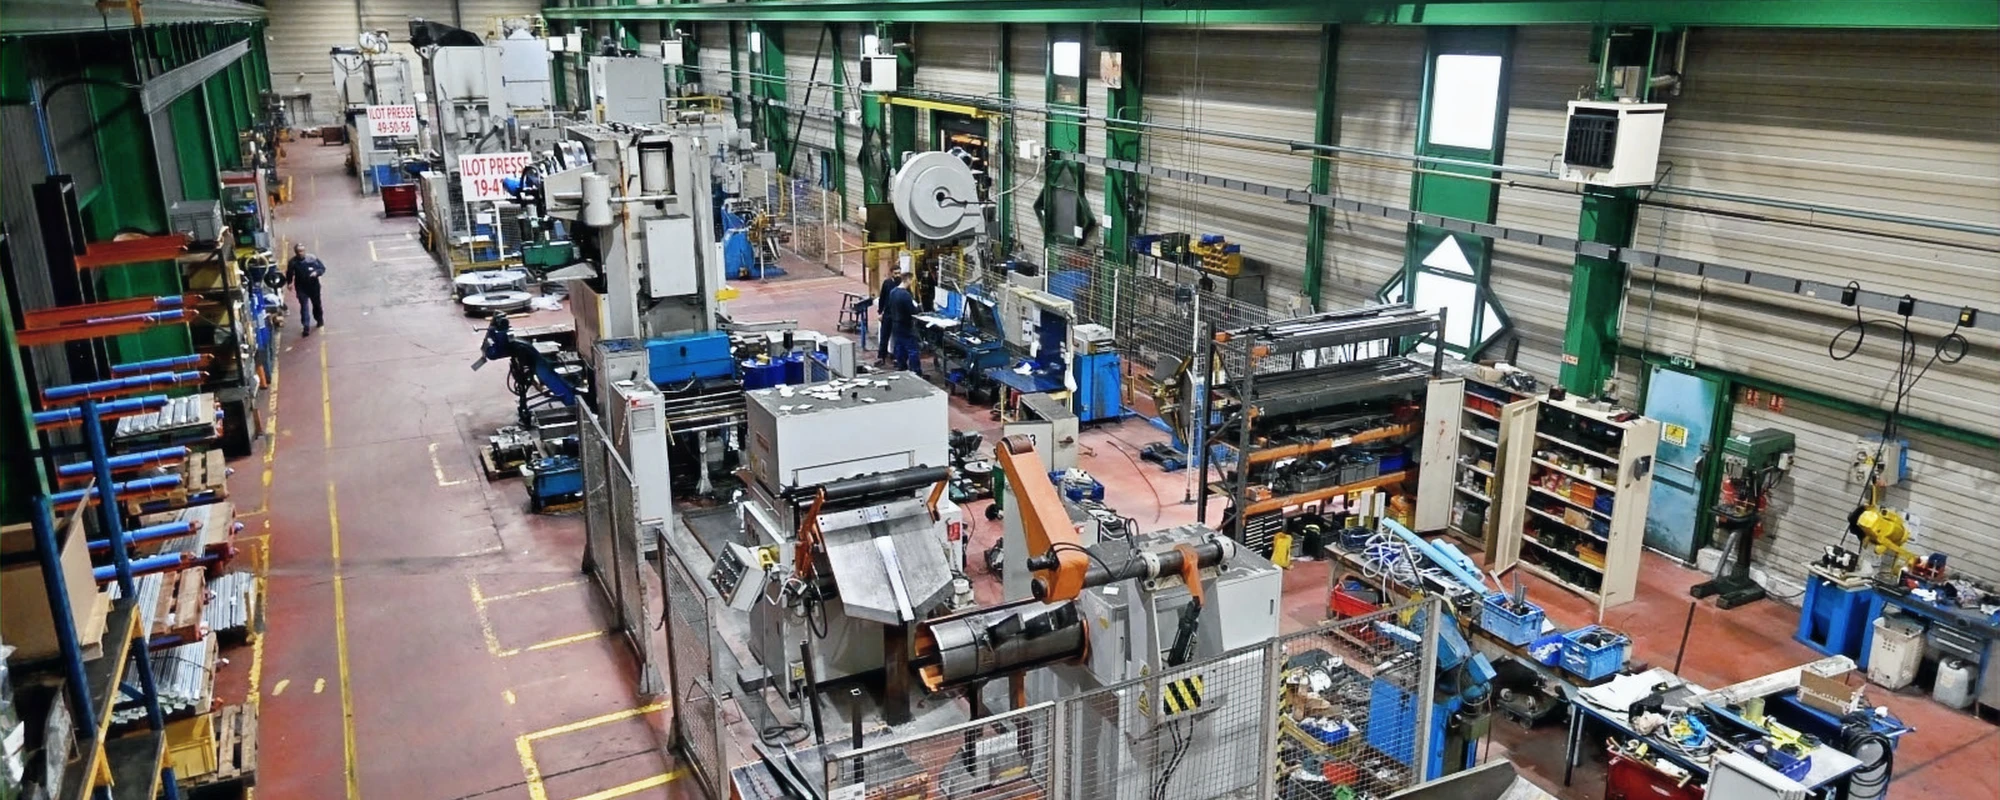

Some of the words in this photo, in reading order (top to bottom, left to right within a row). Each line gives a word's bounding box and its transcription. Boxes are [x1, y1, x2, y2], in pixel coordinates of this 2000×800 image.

[369, 107, 385, 119] ILOT
[387, 107, 414, 119] PRESSE
[377, 121, 411, 133] 49-50-56
[461, 159, 486, 176] ILOT
